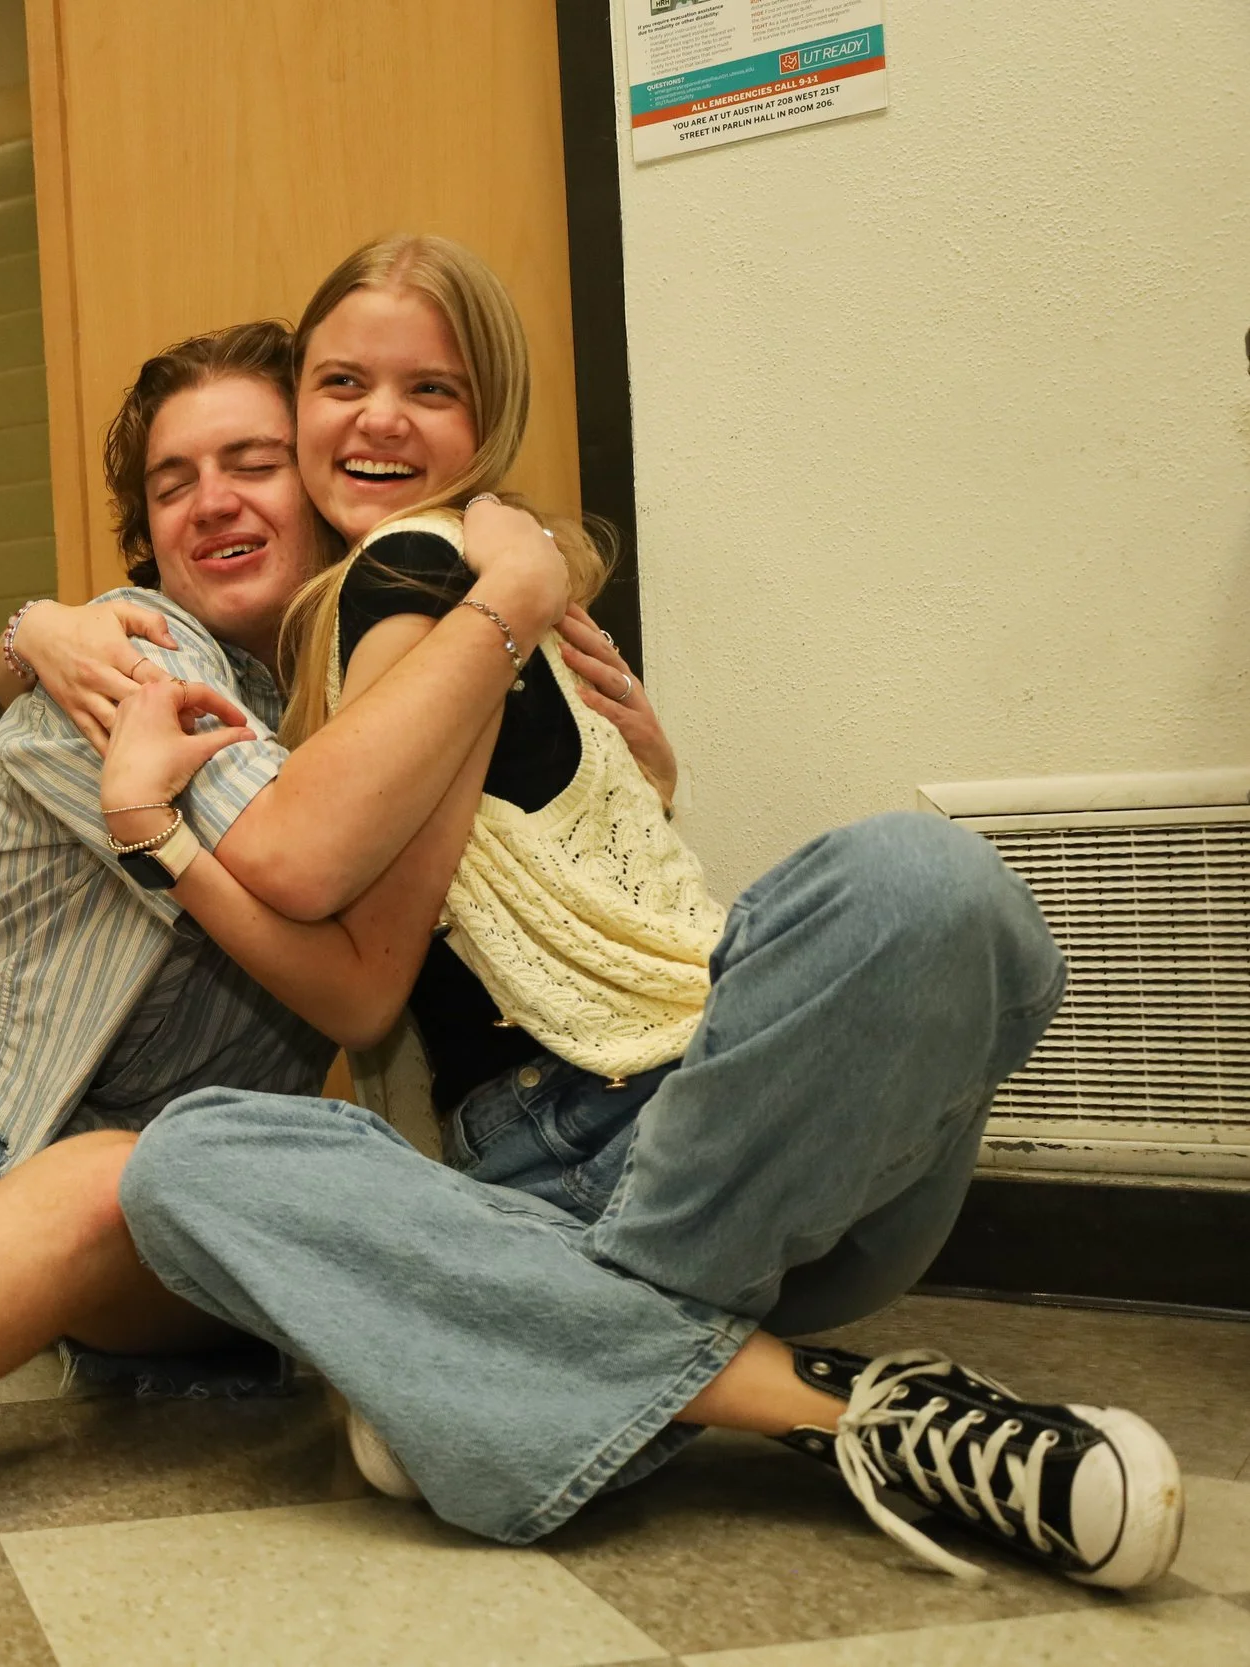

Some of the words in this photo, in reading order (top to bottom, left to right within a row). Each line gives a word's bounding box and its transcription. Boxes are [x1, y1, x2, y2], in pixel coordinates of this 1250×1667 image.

[804, 49, 822, 64] UT
[822, 38, 864, 60] READY
[647, 77, 685, 91] QUESTIONS?
[692, 102, 708, 112] ALL
[709, 86, 772, 107] EMERGENCIES
[775, 81, 797, 92] CALL
[799, 75, 818, 86] 9-1-1
[673, 121, 689, 130] YOU
[691, 117, 707, 126] ARE
[709, 114, 719, 122] AT
[720, 111, 731, 119] UT
[733, 104, 763, 116] AUSTIN
[765, 100, 775, 109] AT
[777, 96, 793, 106] 208
[795, 90, 818, 102] WEST
[820, 85, 840, 96] 21ST
[680, 128, 710, 141] STREET
[723, 118, 751, 131] PARLIN
[754, 113, 775, 123] HALL
[777, 110, 786, 118] IN
[788, 104, 814, 116] ROOM
[816, 99, 834, 109] 206.
